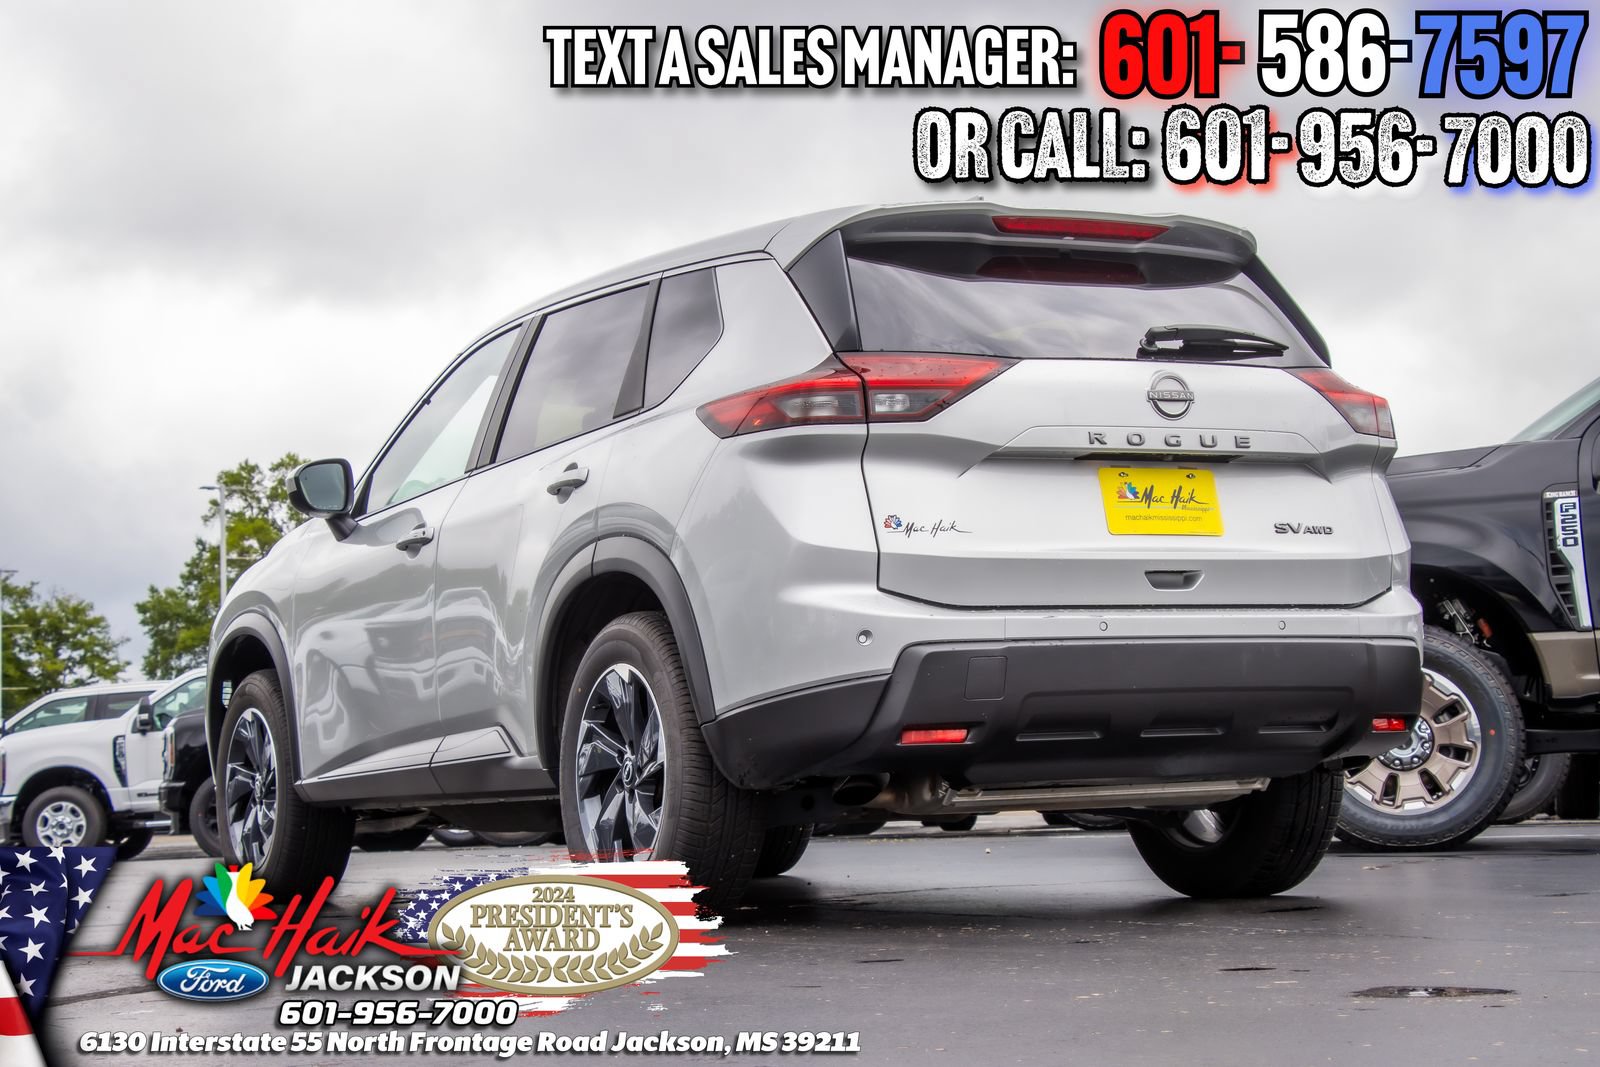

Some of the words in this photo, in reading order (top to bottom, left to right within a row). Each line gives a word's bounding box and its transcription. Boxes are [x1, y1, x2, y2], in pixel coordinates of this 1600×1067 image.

[1148, 391, 1194, 399] NISSAN
[1087, 430, 1252, 449] ROGUE
[1138, 484, 1168, 509] Mac
[1170, 485, 1208, 509] Haik
[899, 522, 928, 538] Mac
[930, 519, 972, 538] Haik
[1274, 522, 1301, 534] SV
[1303, 525, 1334, 535] AWD
